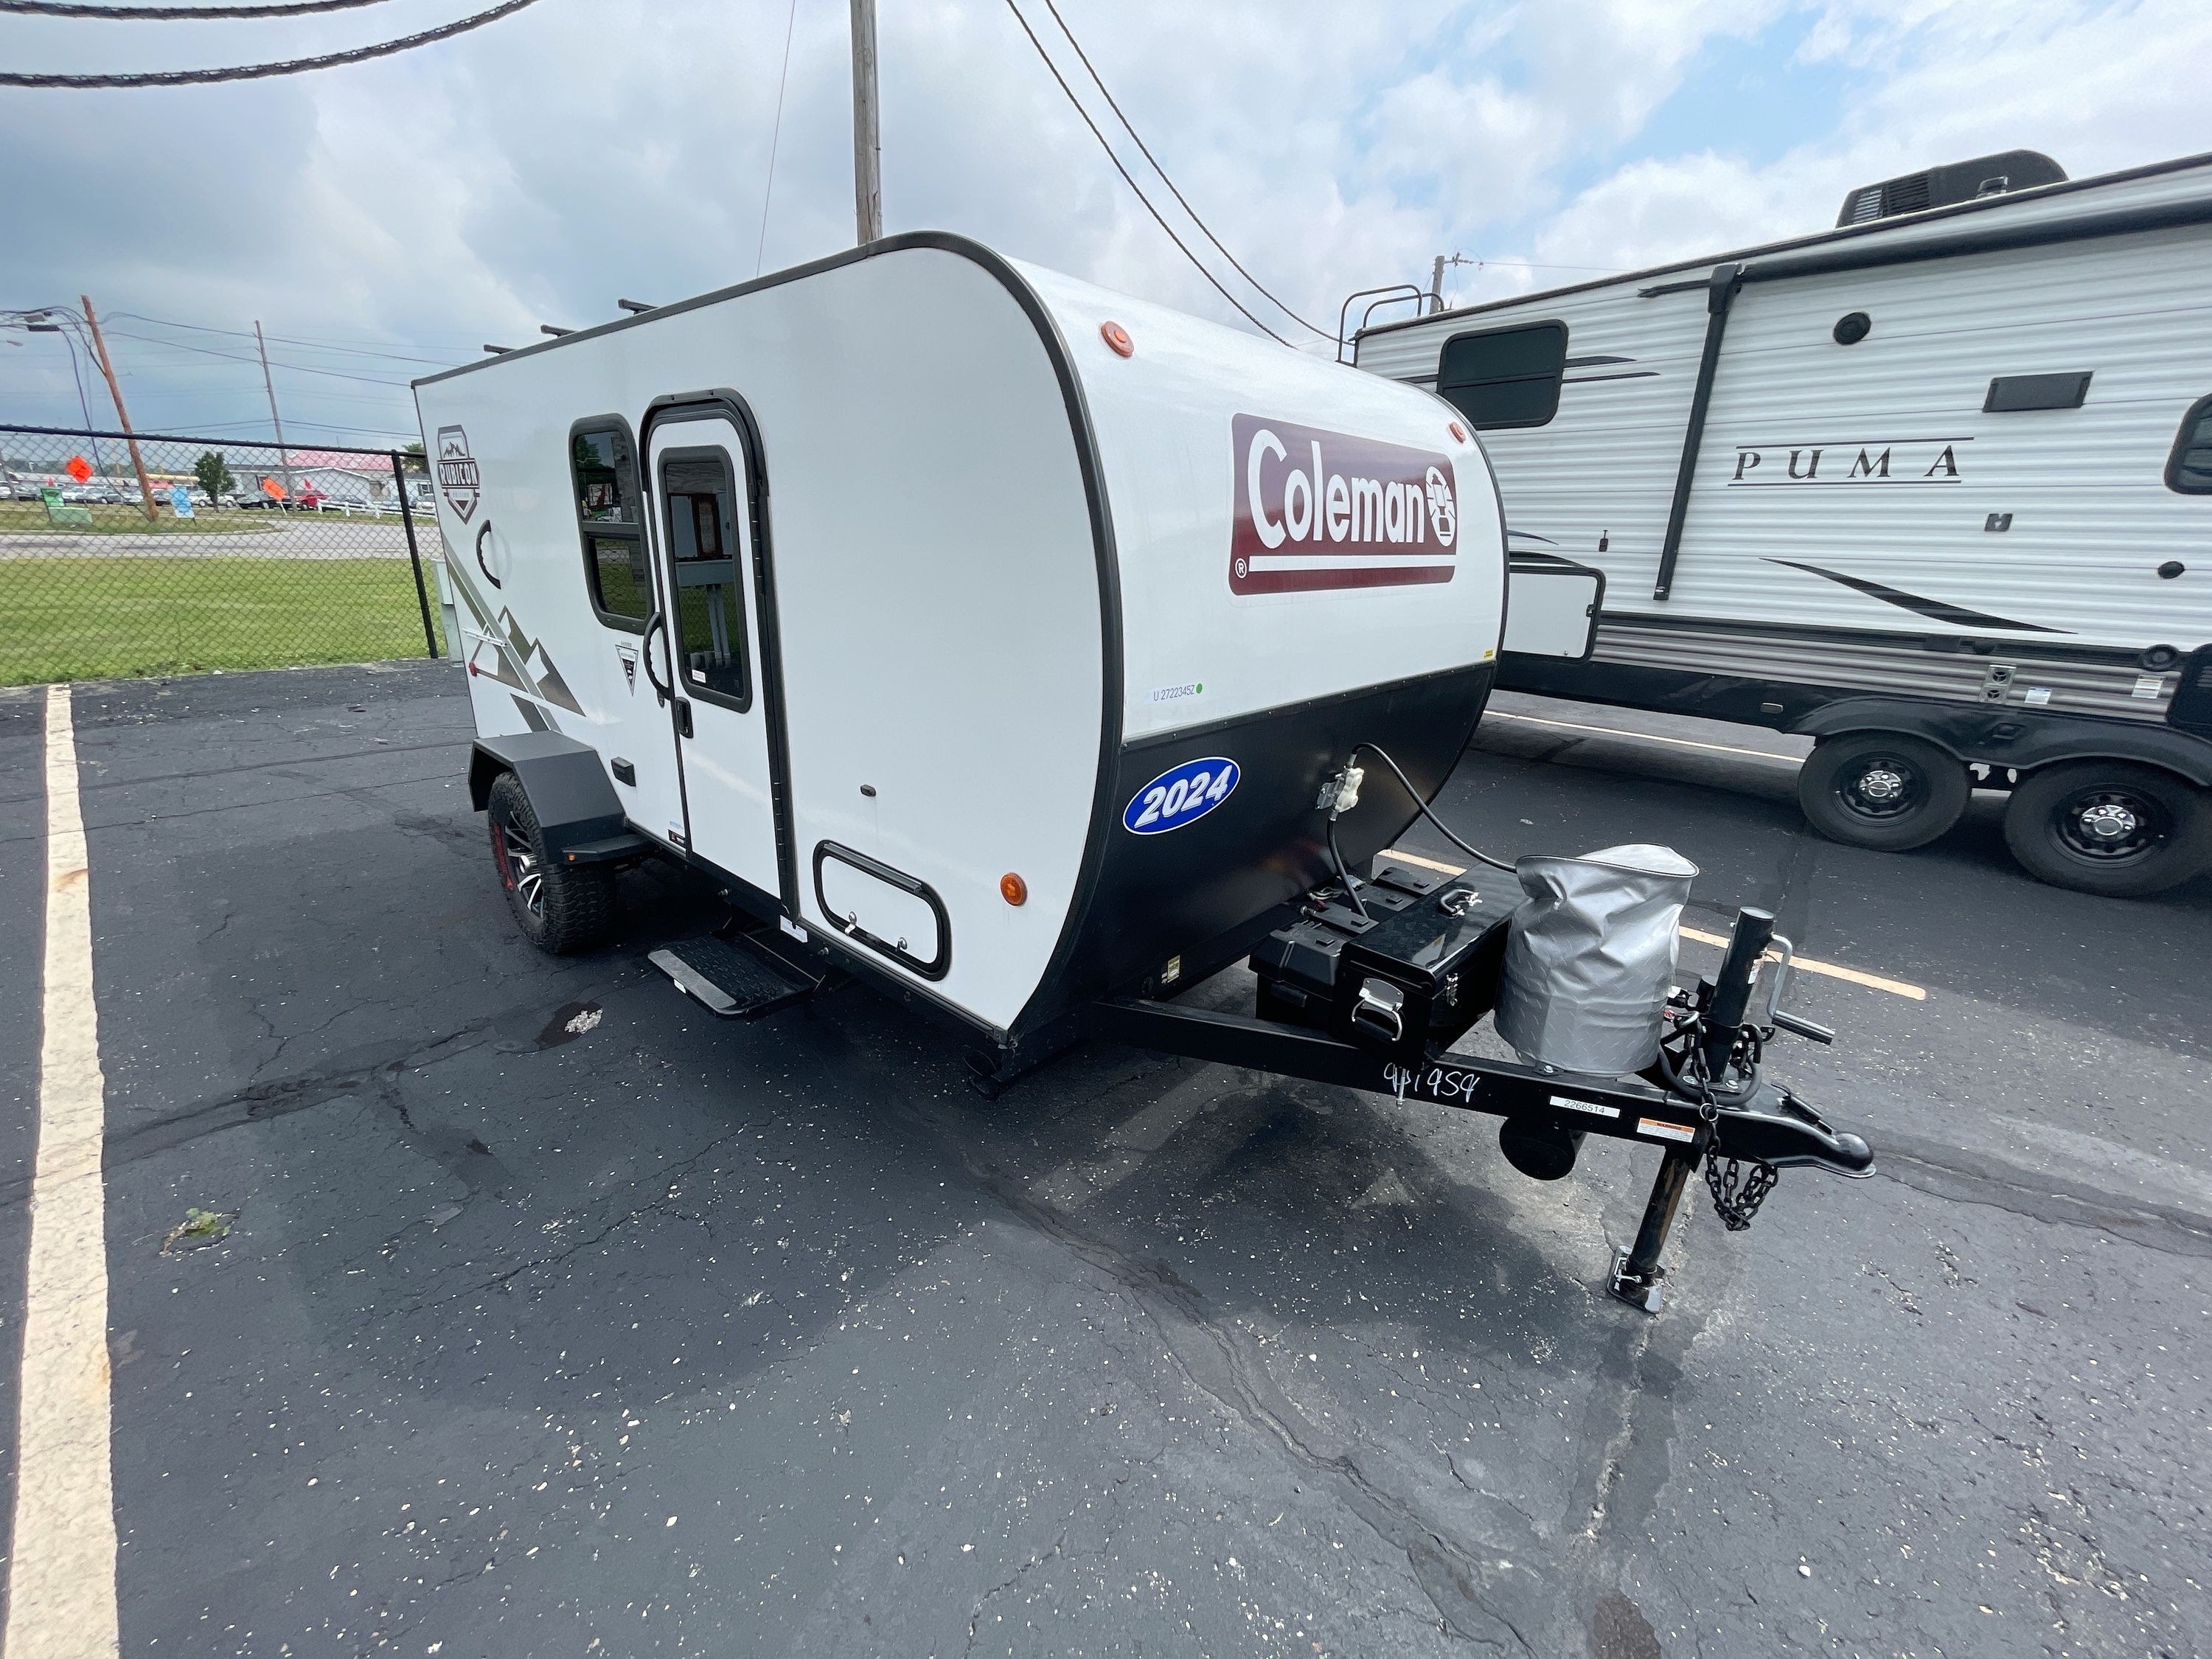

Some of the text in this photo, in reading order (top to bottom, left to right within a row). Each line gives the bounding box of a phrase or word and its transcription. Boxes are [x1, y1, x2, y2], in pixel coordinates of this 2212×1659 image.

[439, 462, 479, 485] RUBICON
[1731, 445, 1961, 480] PUMA
[1248, 429, 1425, 549] Coleman
[1153, 690, 1159, 701] U
[1134, 765, 1233, 829] 2024
[1564, 1099, 1605, 1114] 2266514
